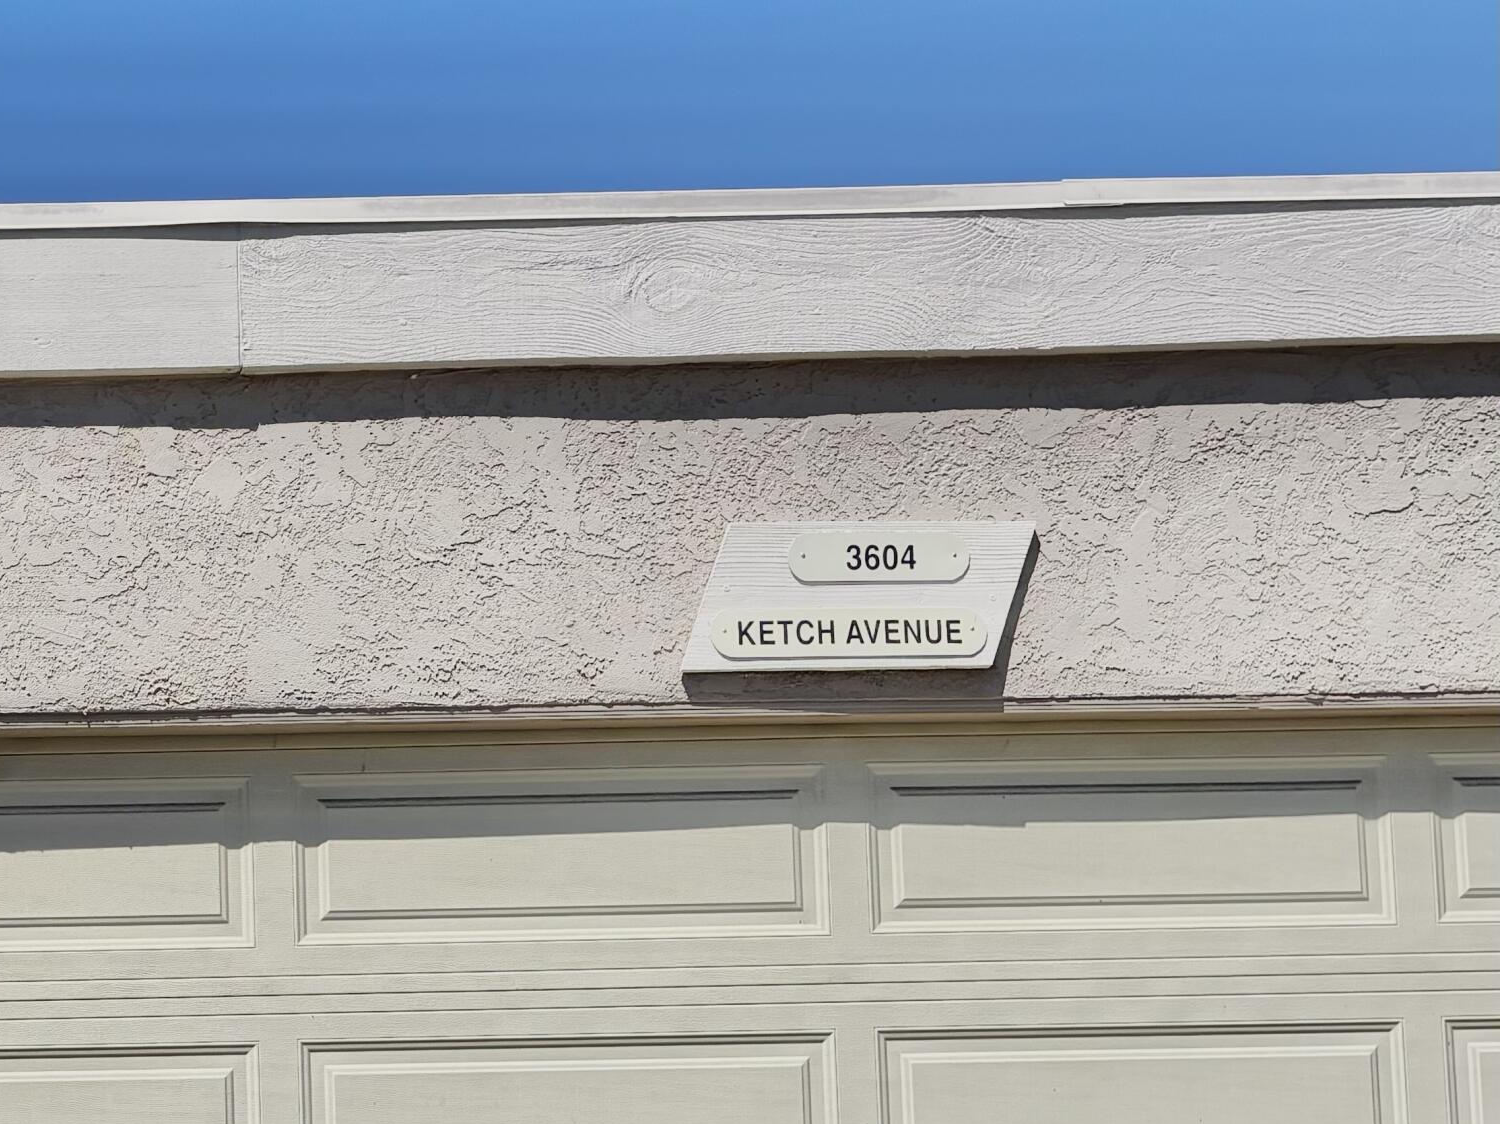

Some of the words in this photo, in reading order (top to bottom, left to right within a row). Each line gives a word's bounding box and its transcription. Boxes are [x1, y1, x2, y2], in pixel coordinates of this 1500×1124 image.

[846, 544, 917, 571] 3604
[737, 620, 835, 646] KETCH
[846, 619, 963, 645] AVENUE
